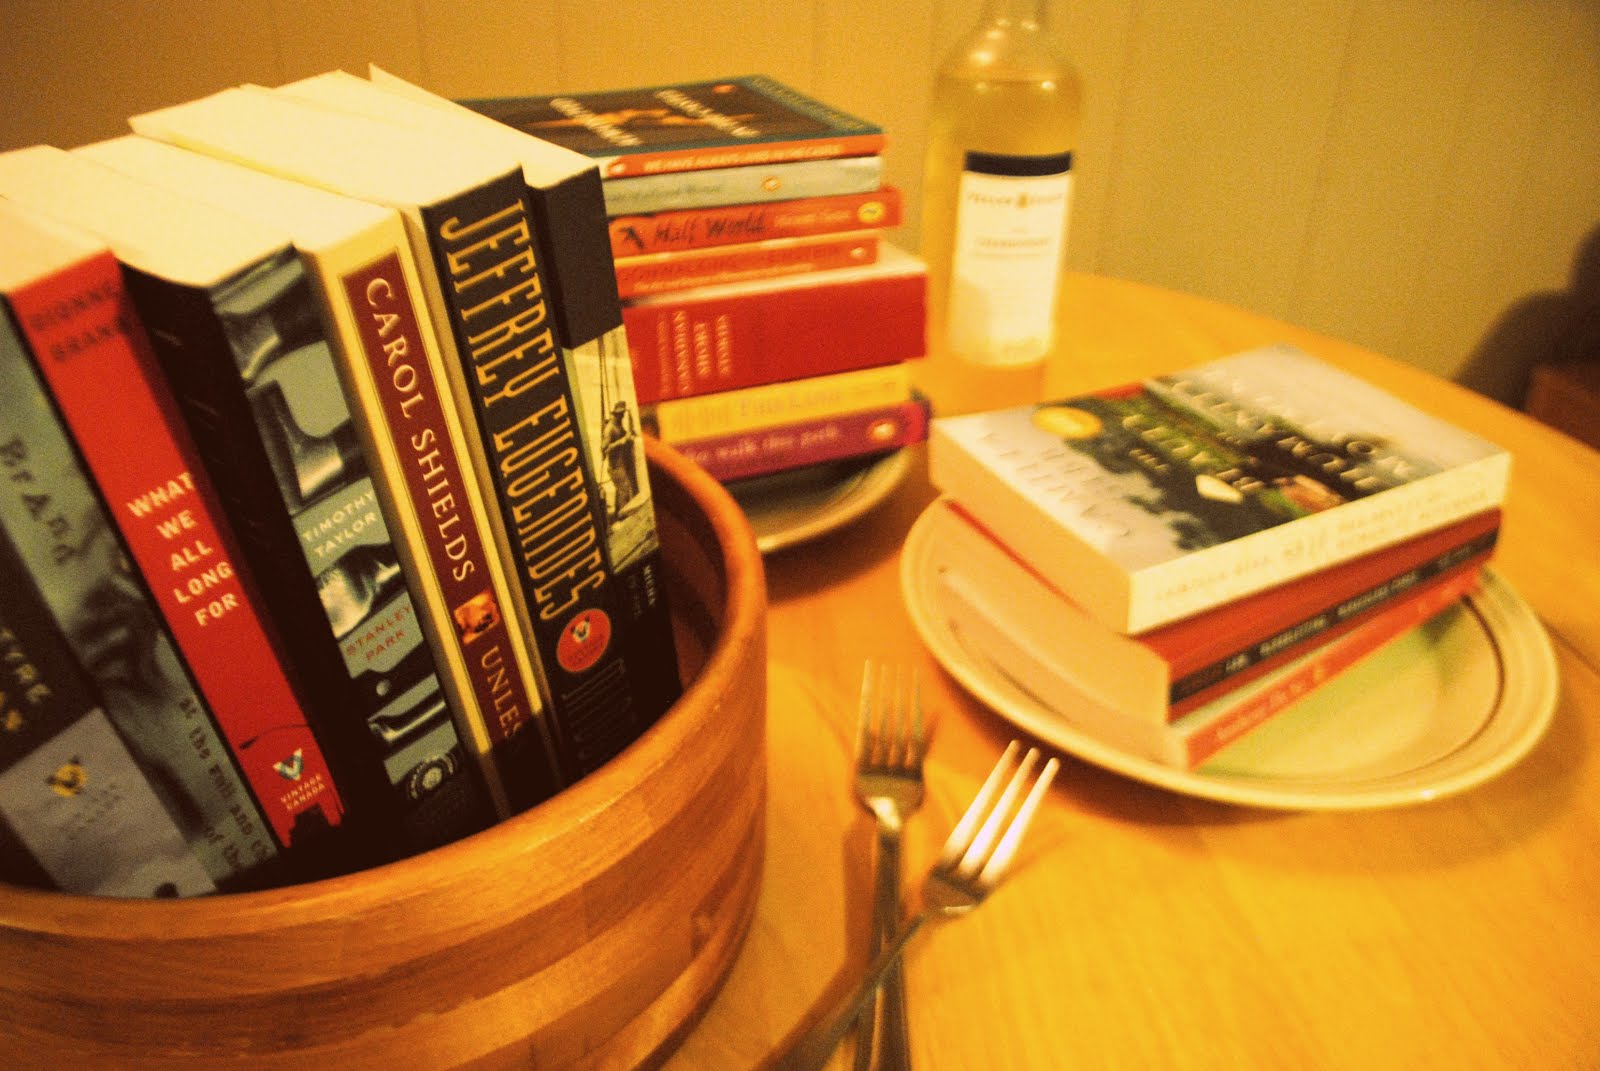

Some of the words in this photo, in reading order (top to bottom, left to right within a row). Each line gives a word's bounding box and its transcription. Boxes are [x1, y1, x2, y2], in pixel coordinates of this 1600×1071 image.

[439, 198, 562, 407] JEFFREY
[366, 276, 424, 420] CAROL
[411, 433, 476, 583] SHIELDS
[127, 471, 196, 518] WHAT
[302, 489, 375, 543] TIMOTHY
[494, 397, 608, 622] EUGENIDES
[157, 511, 197, 540] WE
[314, 512, 378, 559] TAYLOR
[170, 538, 214, 572] ALL
[173, 560, 234, 604] LONG
[195, 593, 238, 626] FOR
[345, 602, 411, 657] STANLEY
[365, 628, 406, 662] PARK
